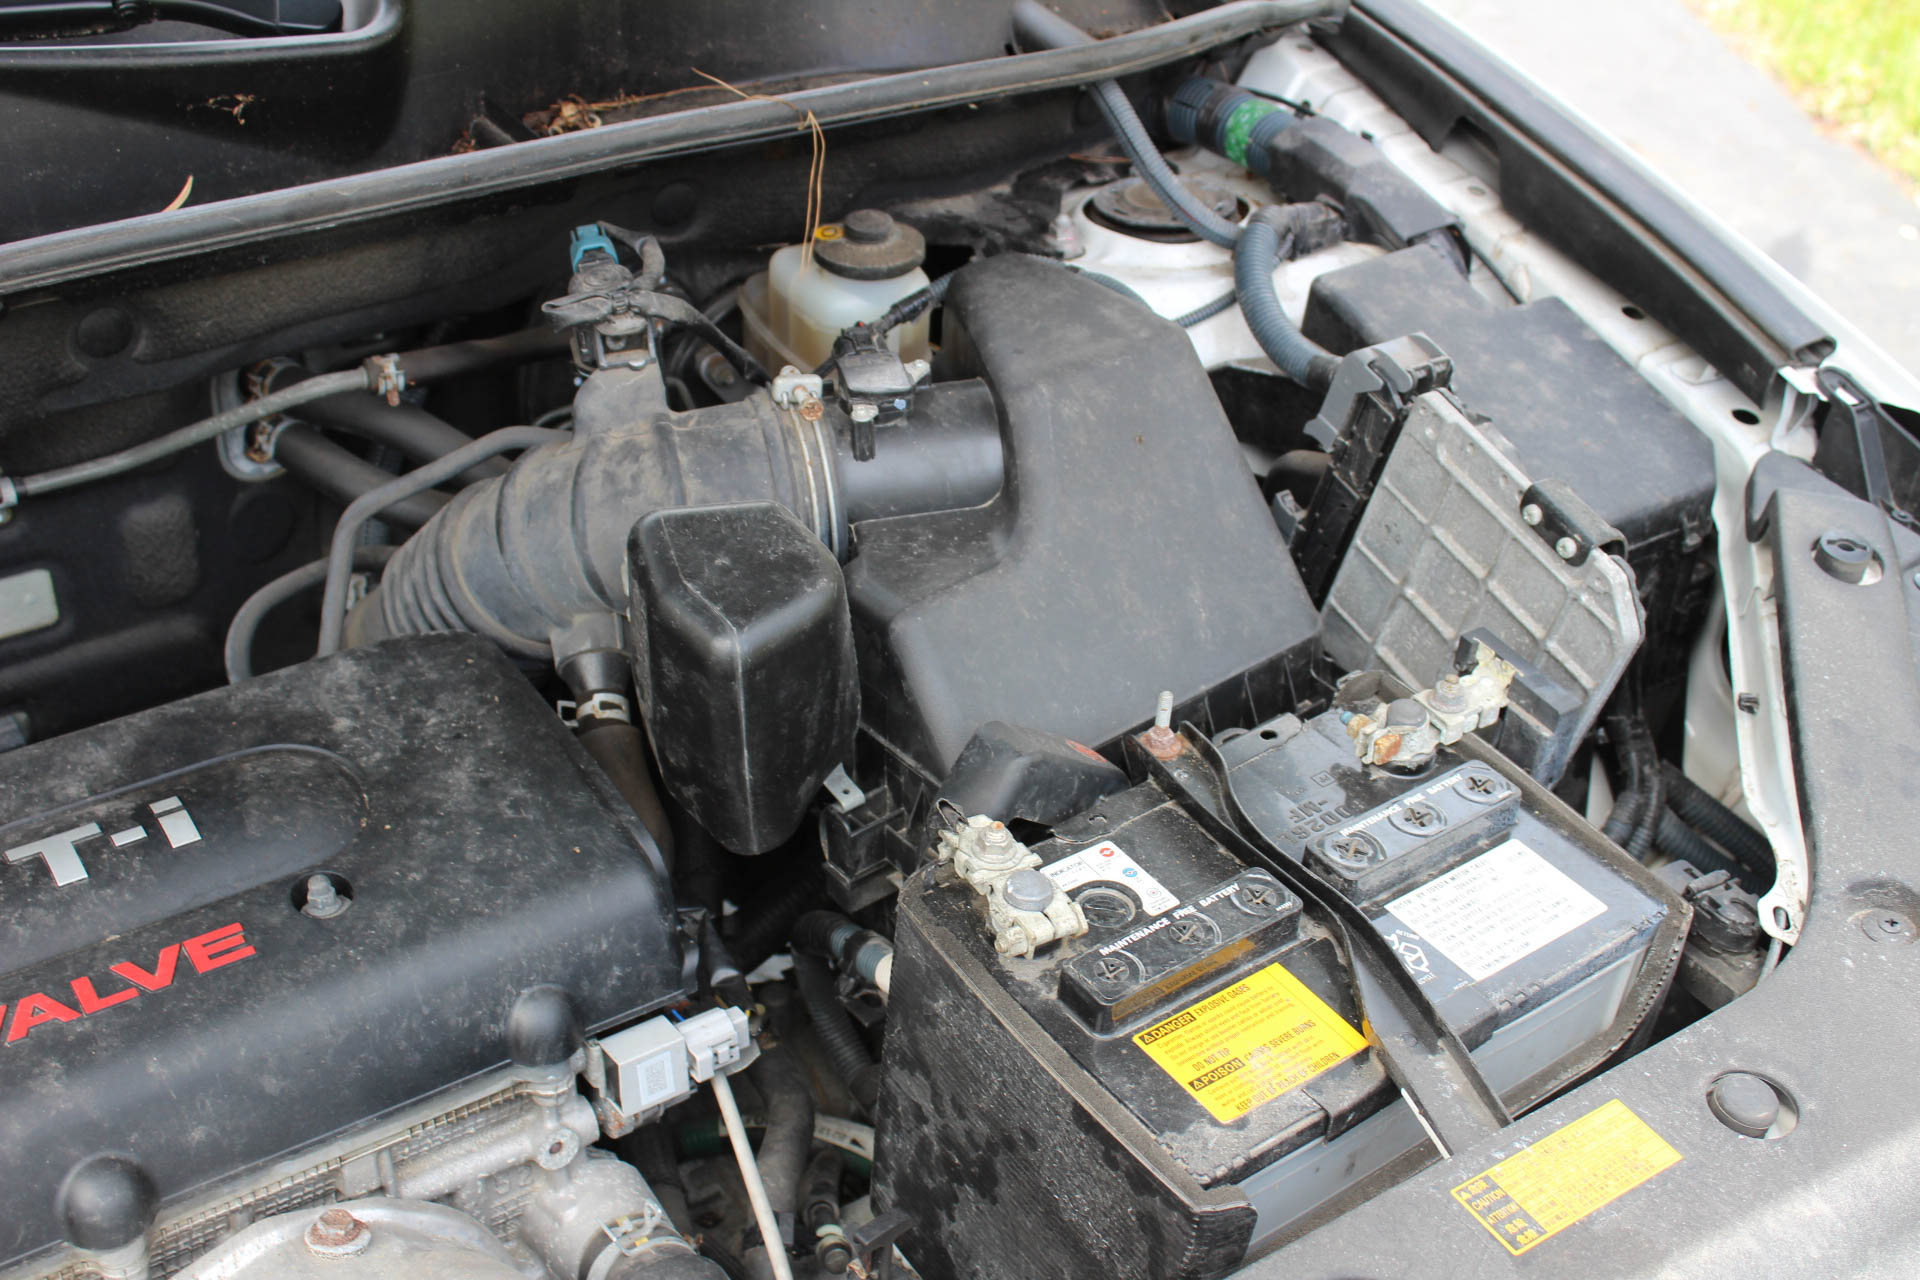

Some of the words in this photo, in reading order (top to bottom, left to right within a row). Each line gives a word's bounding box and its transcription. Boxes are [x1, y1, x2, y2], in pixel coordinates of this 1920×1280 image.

[1339, 804, 1403, 837] MAINTENANCE
[1426, 774, 1463, 795] BATTERY
[1100, 917, 1171, 956] MAINTENANCE
[1172, 905, 1198, 919] FREE
[1198, 883, 1241, 908] BATTERY
[0, 922, 256, 1043] ALVE
[1151, 1013, 1193, 1037] DANGER
[1194, 994, 1229, 1016] EXPLOSIVE
[1227, 984, 1250, 999] GASES
[1192, 1062, 1205, 1071] DO
[1204, 1053, 1219, 1065] NOT
[1218, 1047, 1230, 1057] TIP
[1201, 1059, 1242, 1083] POISON
[1269, 1031, 1294, 1047] SEVERE
[1291, 1020, 1317, 1035] BURNS
[1236, 1098, 1254, 1112] KEEP
[1252, 1091, 1268, 1102] OUT
[1276, 1073, 1300, 1089] REACH
[1306, 1052, 1340, 1073] CHILDREN
[1471, 1187, 1508, 1211] CAUTION
